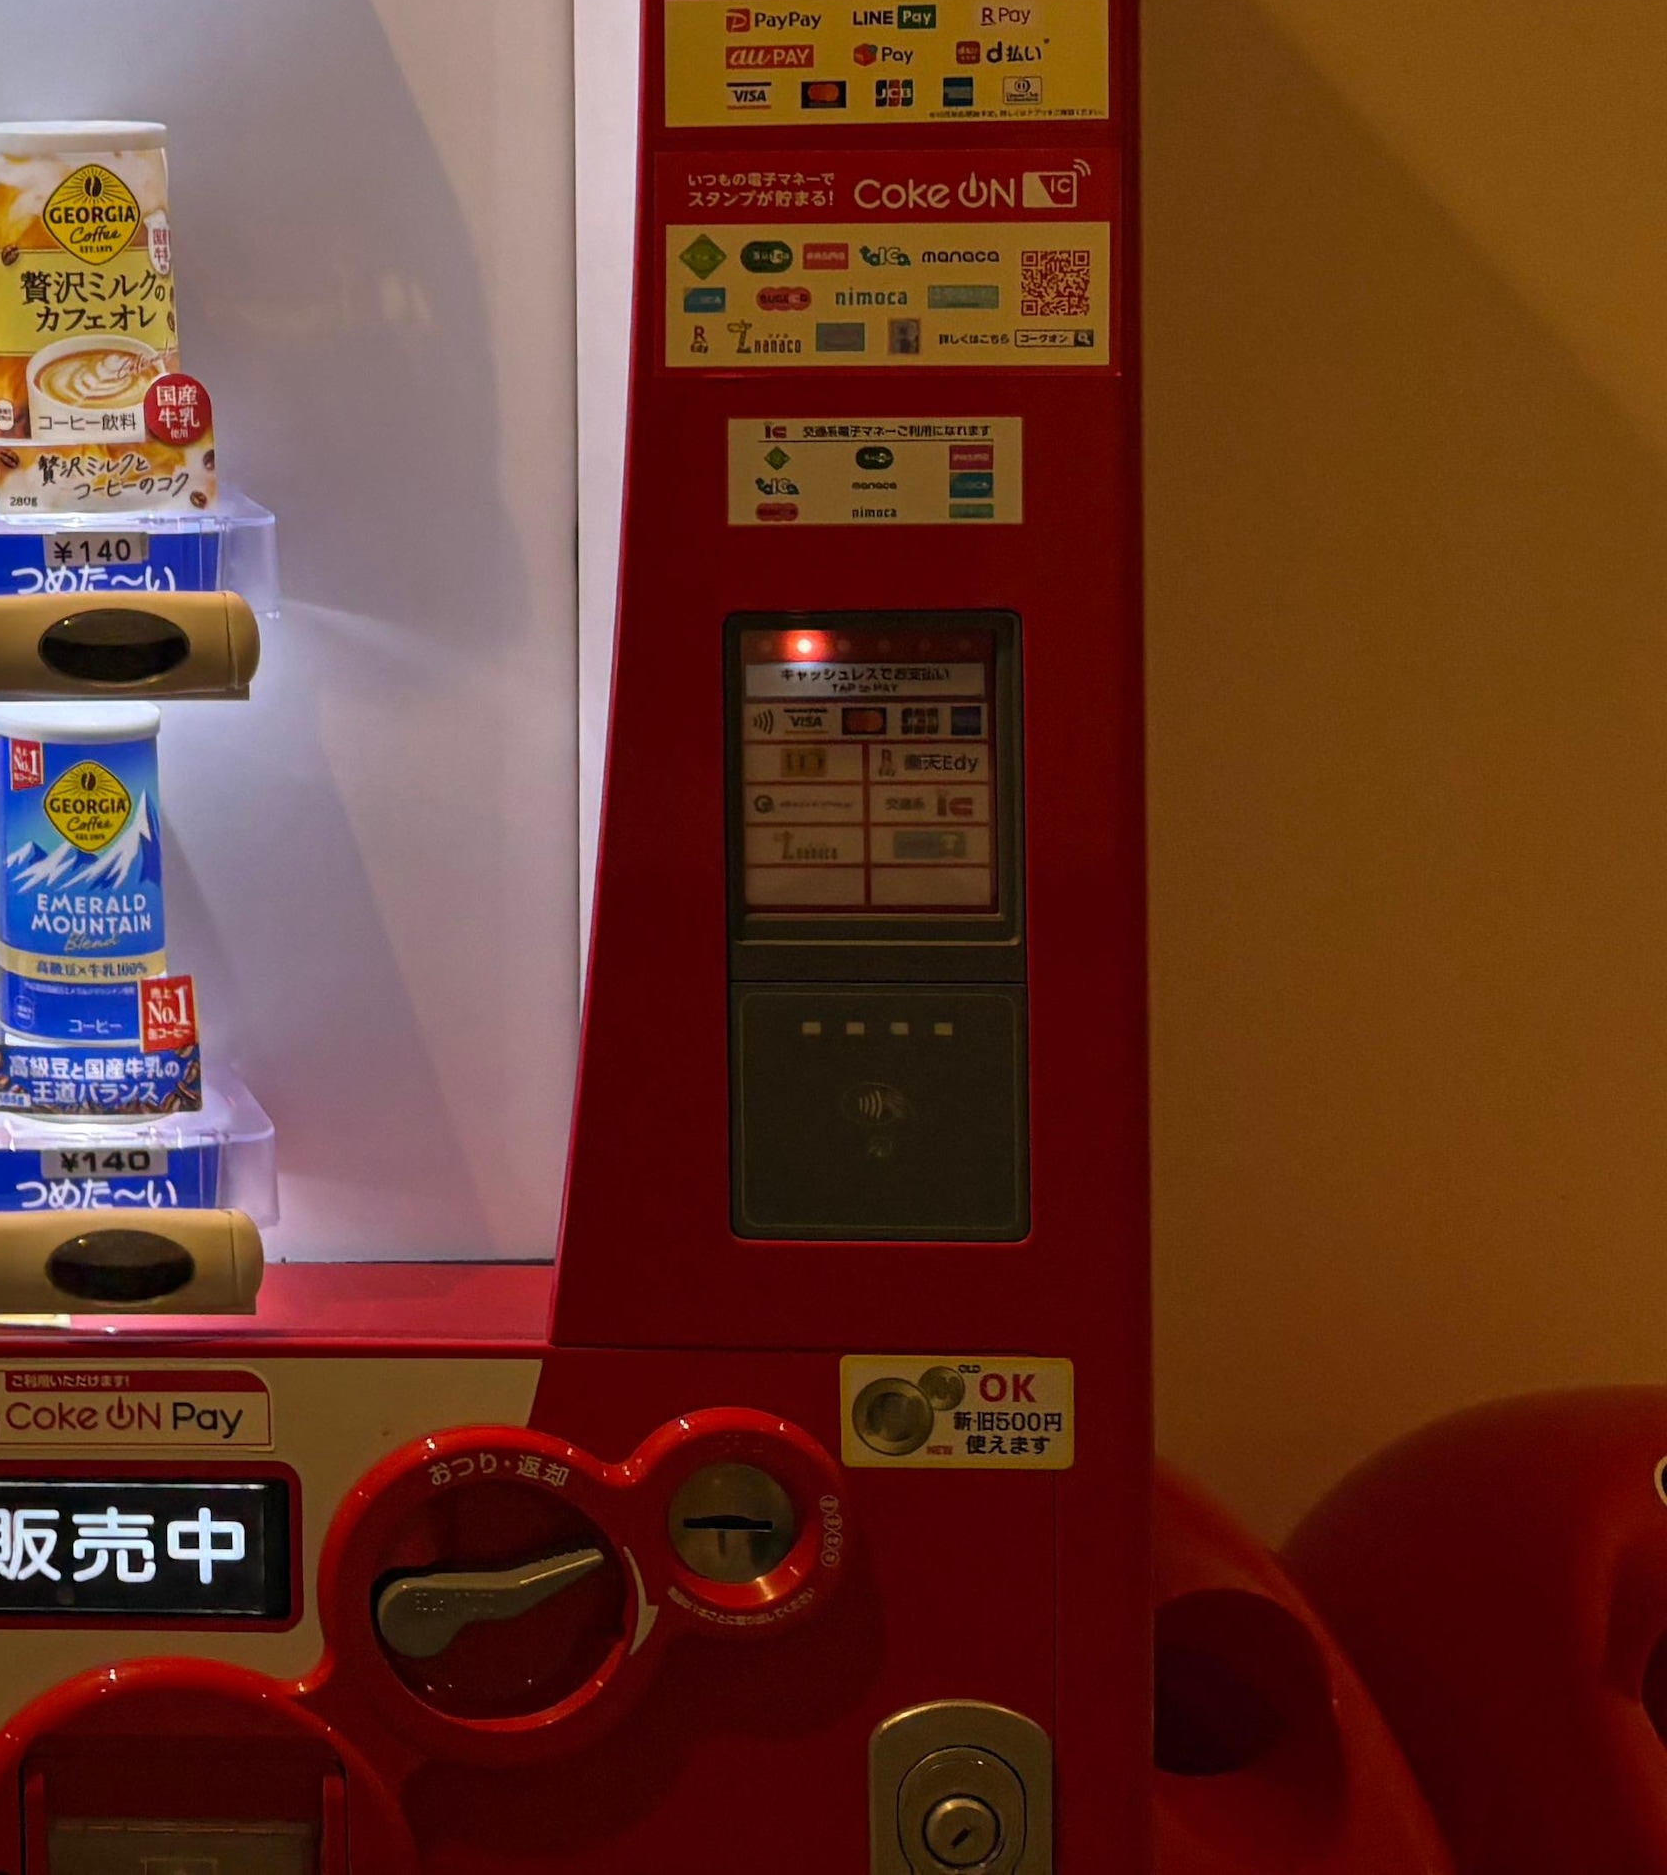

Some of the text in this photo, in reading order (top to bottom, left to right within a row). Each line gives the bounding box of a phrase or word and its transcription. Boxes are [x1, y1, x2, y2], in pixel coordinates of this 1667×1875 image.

[755, 11, 821, 29] PayPay
[853, 11, 932, 25] LINE Pay
[998, 7, 1030, 26] Pay
[773, 49, 809, 65] PAY
[882, 47, 913, 64] Pay
[986, 43, 1042, 64] d払い
[733, 89, 767, 102] VISA
[688, 173, 834, 187] いつもの電子マネーで
[688, 190, 834, 208] スタンプが貯まる!
[854, 178, 950, 209] Coke
[922, 251, 999, 263] manaca
[835, 289, 907, 306] nimoca
[54, 538, 131, 563] ¥140
[978, 1373, 1037, 1403] OK
[6, 1403, 98, 1431] Coke
[173, 1402, 243, 1439] Pay
[428, 1452, 570, 1489] おつり・返却
